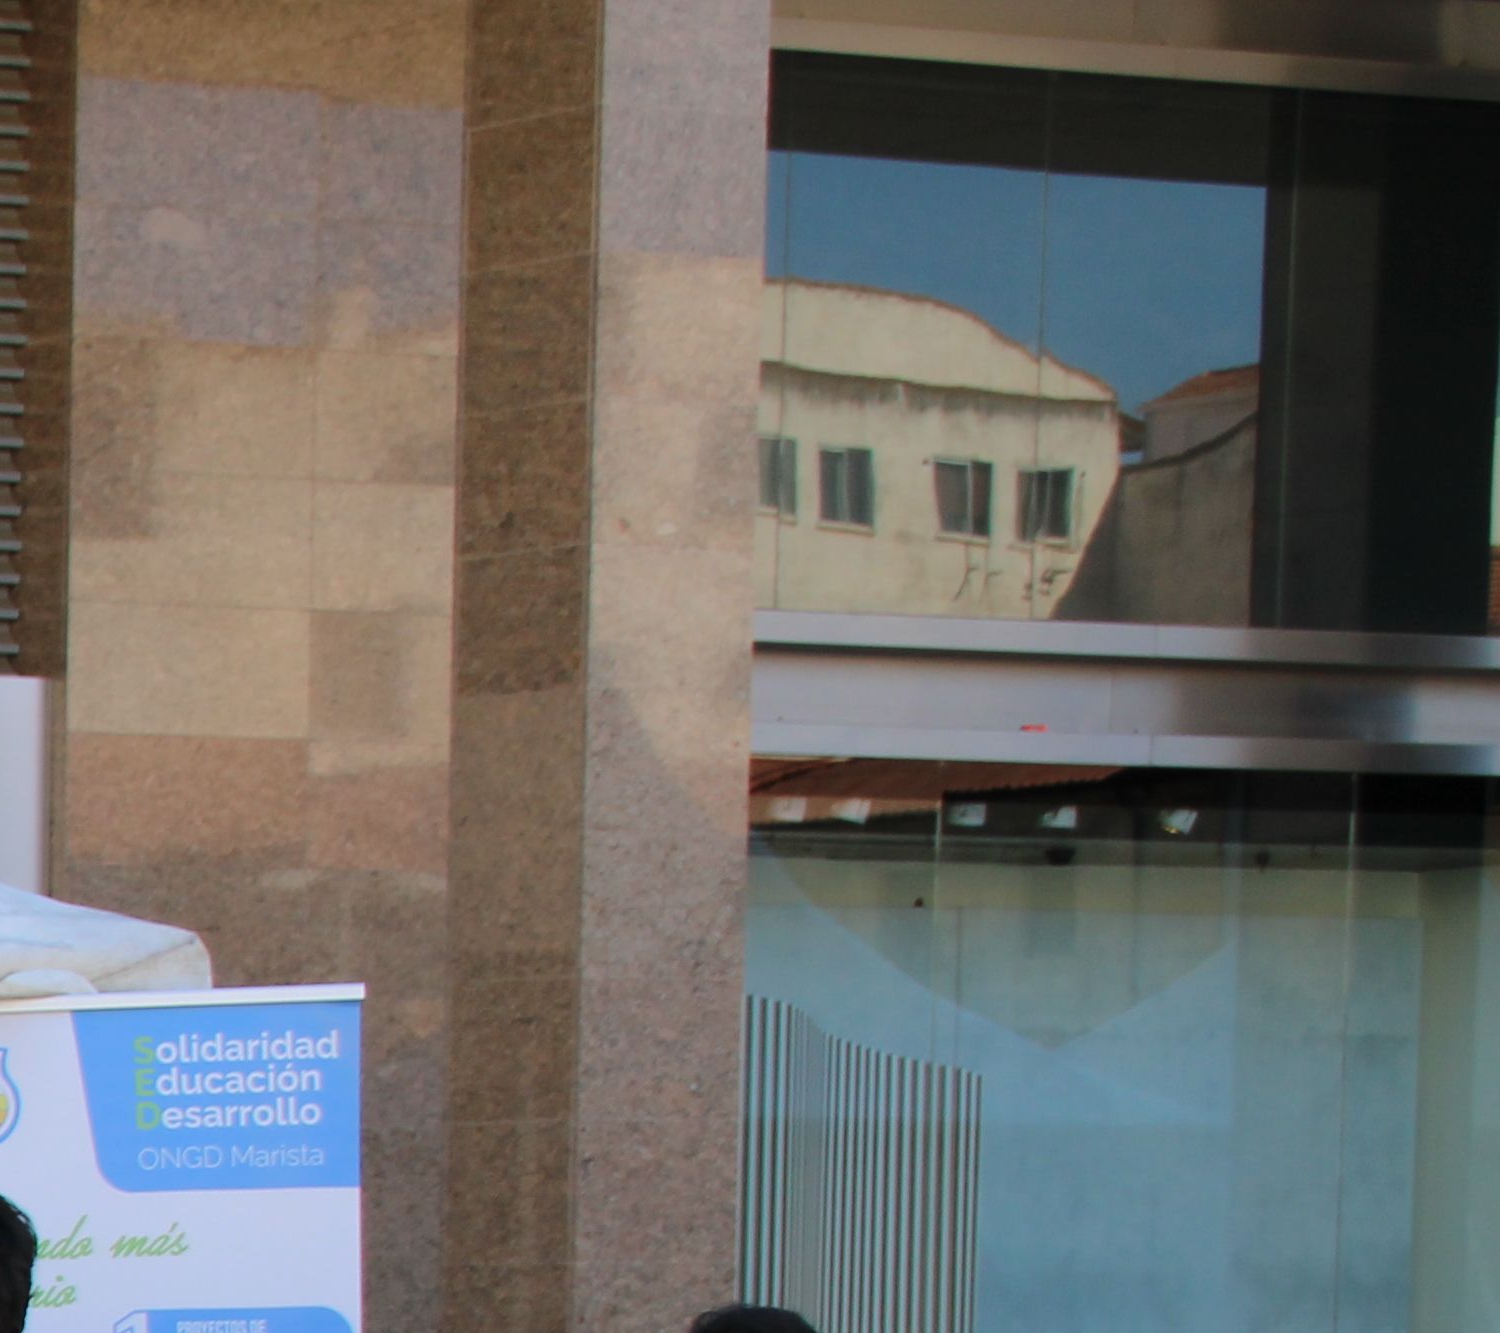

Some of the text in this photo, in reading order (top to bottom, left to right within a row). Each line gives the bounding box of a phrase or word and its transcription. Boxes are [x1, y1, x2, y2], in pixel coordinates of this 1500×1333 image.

[132, 1029, 340, 1064] Solidaridad
[133, 1063, 323, 1097] Educación
[135, 1097, 323, 1131] Desarrollo
[138, 1144, 325, 1171] ONGD Marista
